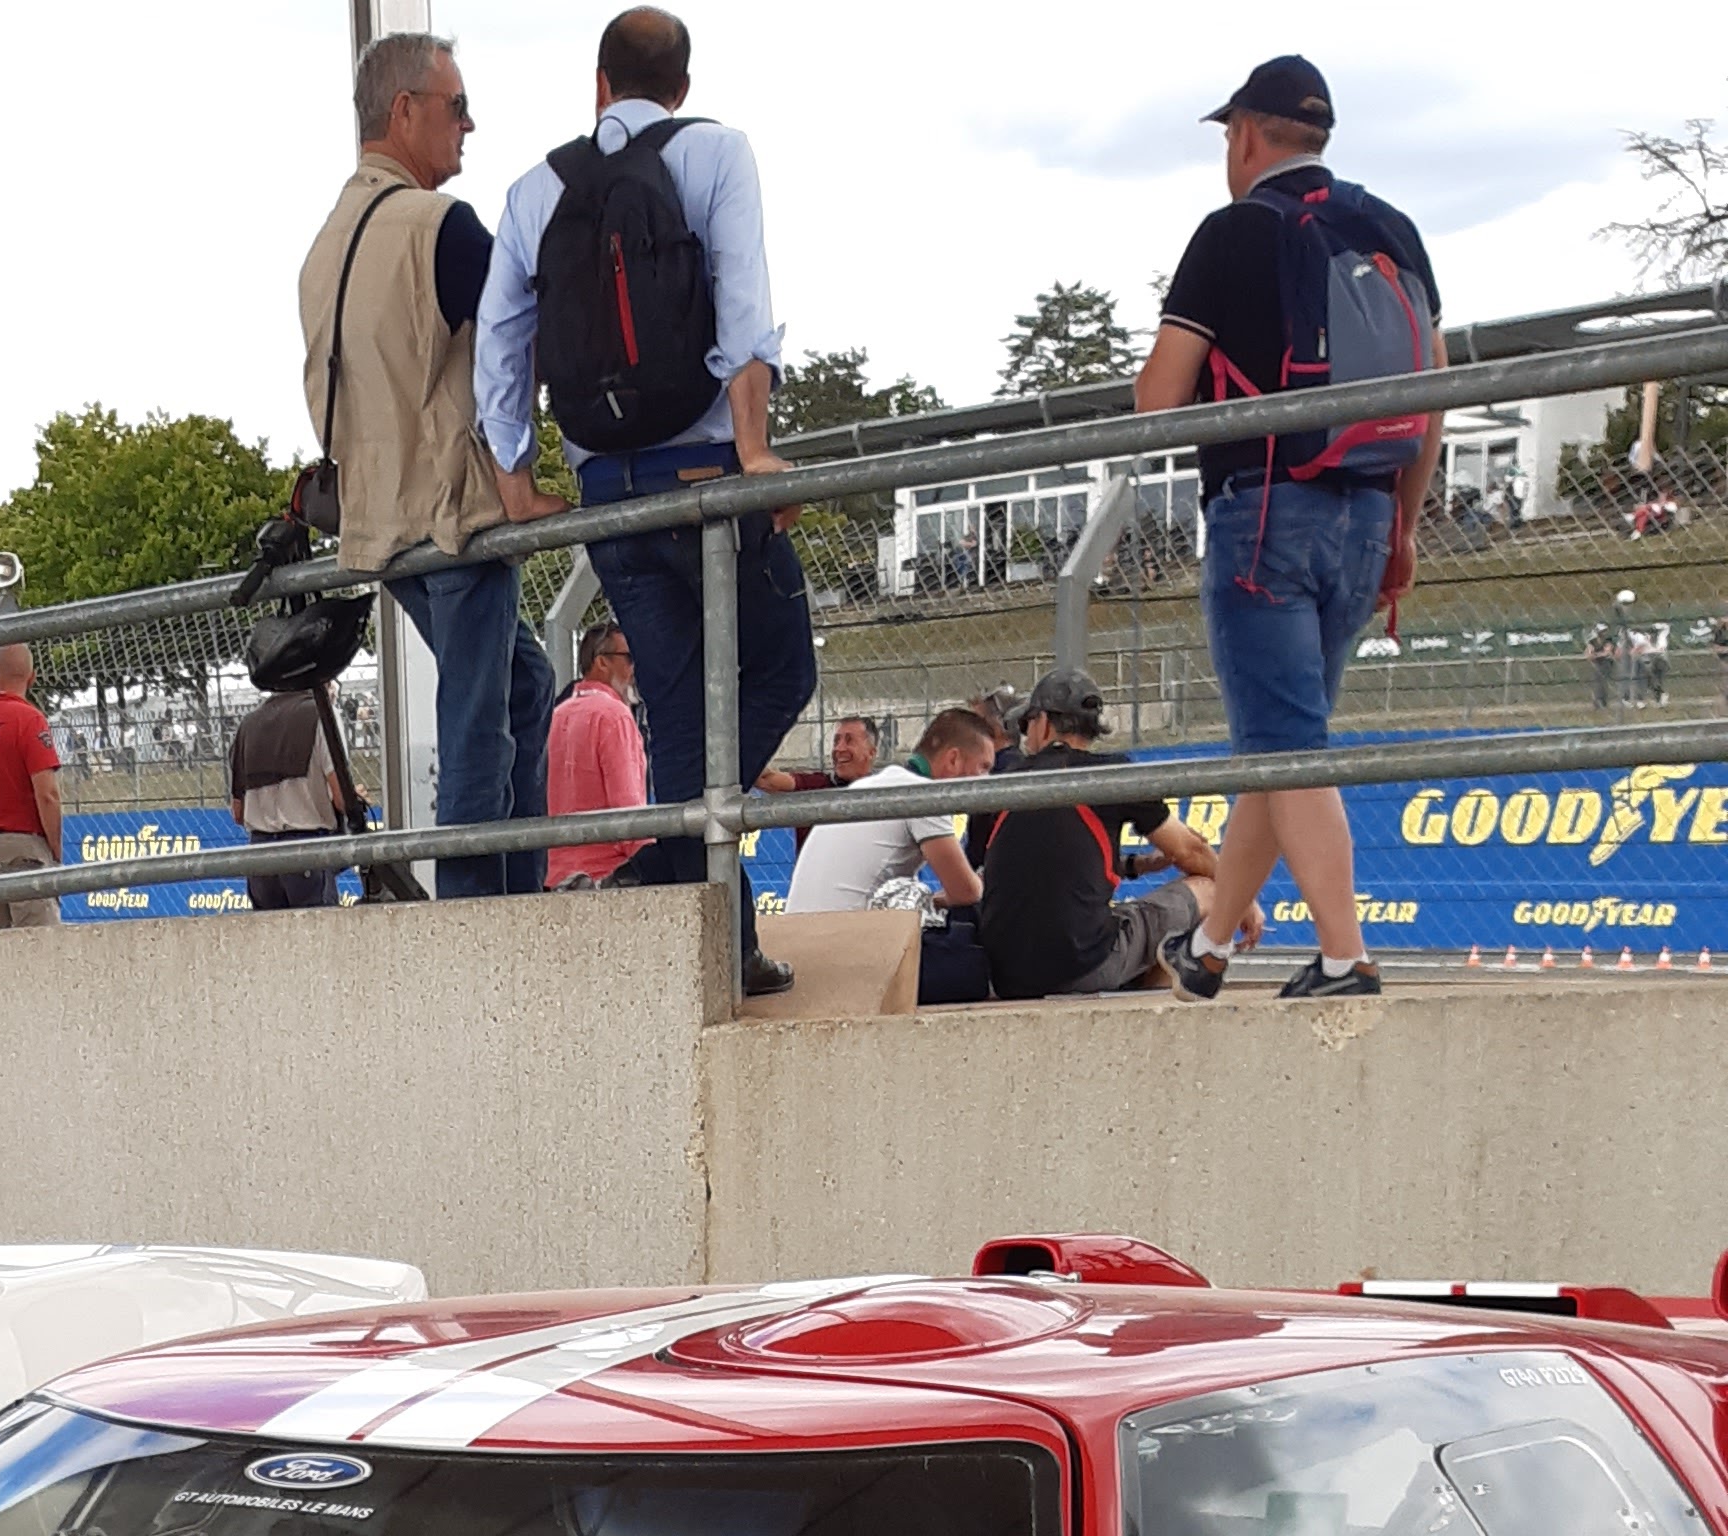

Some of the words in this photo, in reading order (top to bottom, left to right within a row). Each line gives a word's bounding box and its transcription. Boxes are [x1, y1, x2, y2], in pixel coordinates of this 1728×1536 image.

[1400, 776, 1728, 858] GOODYE
[87, 890, 149, 911] GOODYEAR
[1273, 899, 1419, 923] GOYEAR
[1514, 898, 1677, 929] GOODYEAR
[269, 1458, 344, 1482] Ford
[174, 1491, 196, 1503] GT
[195, 1492, 303, 1512] AUTOMOBILES
[300, 1501, 323, 1514] LE
[322, 1503, 374, 1520] MANS
